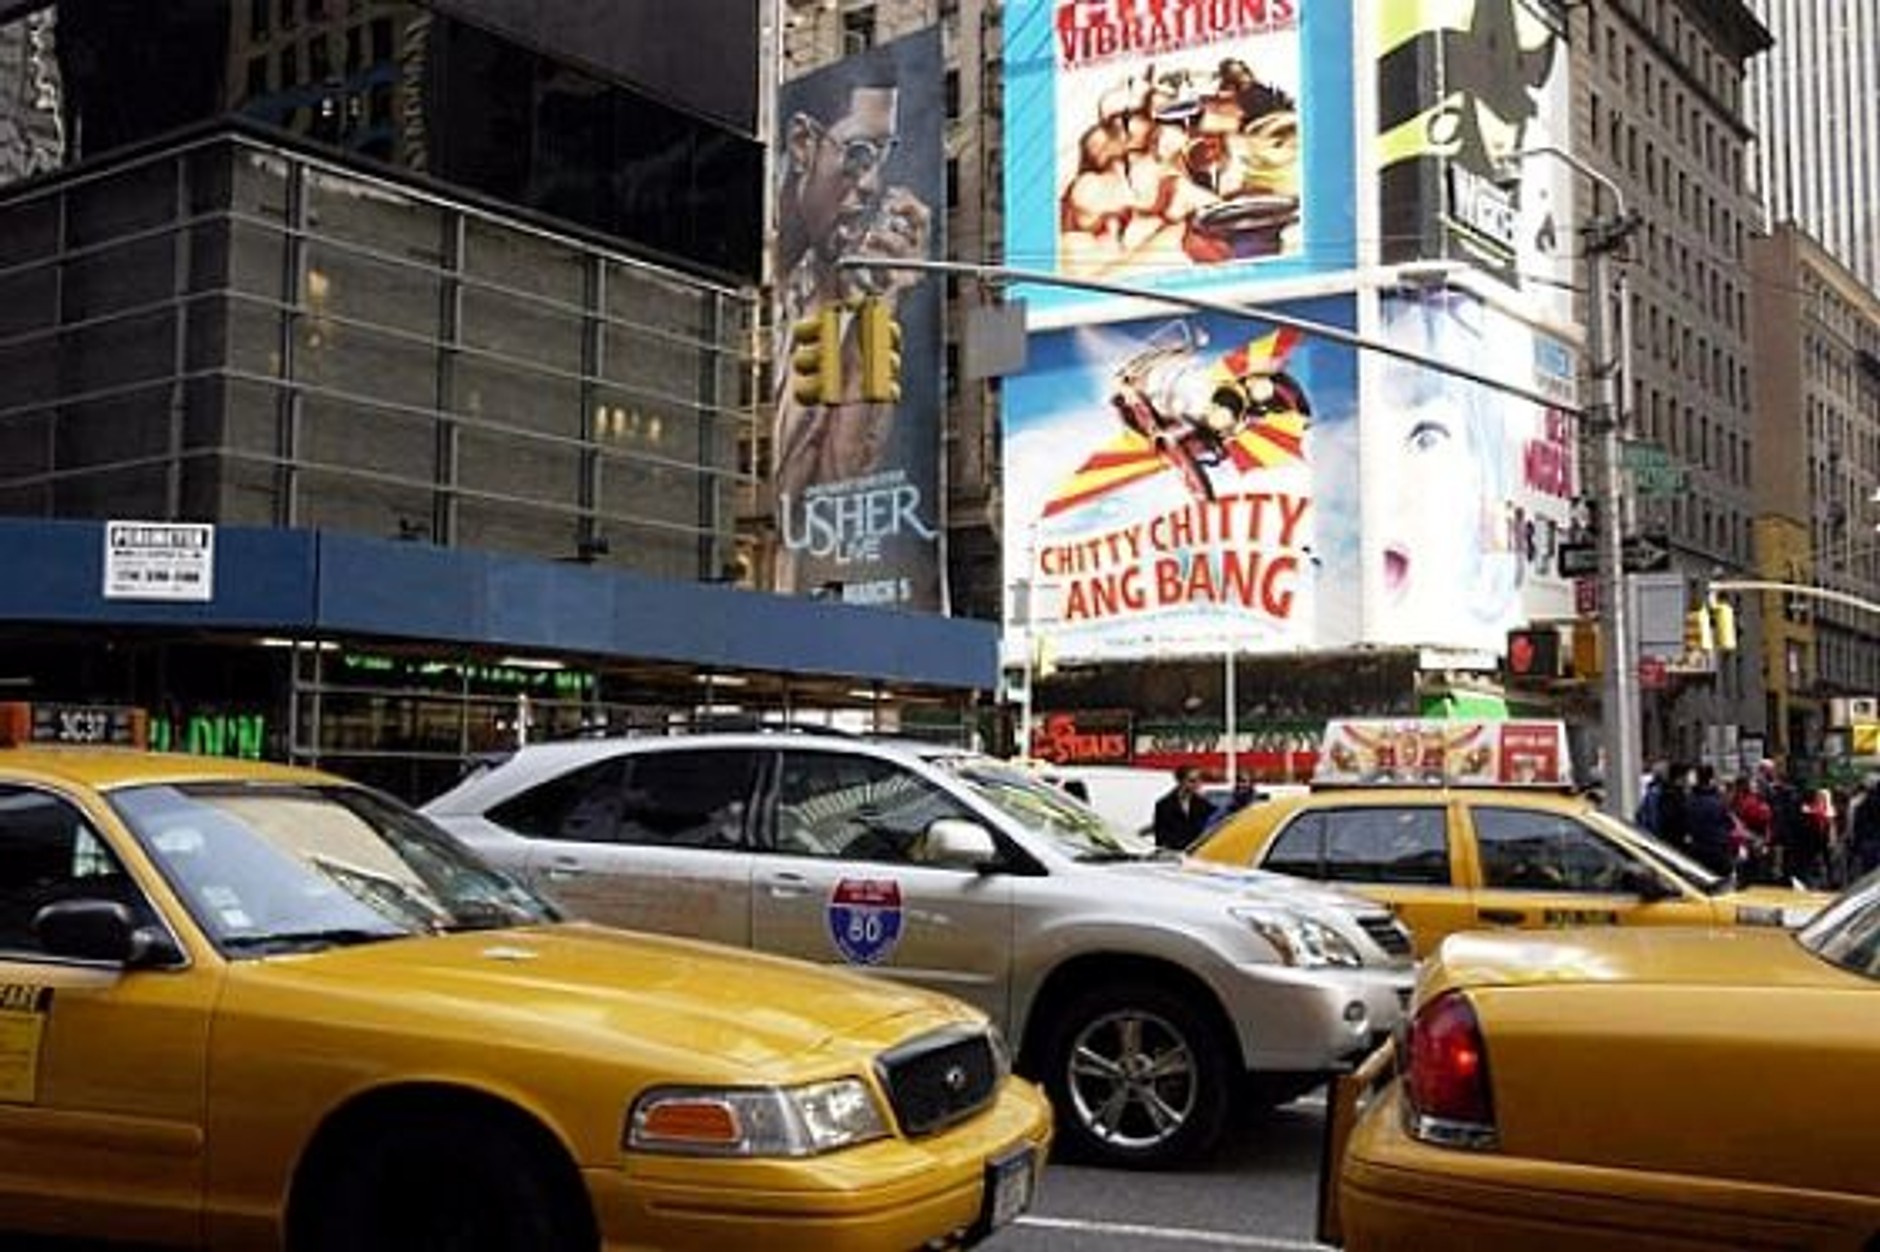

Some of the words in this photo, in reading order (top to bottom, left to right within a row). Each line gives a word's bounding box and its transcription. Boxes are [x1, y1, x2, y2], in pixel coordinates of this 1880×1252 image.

[1059, 0, 1293, 61] VIBRATIONS
[780, 485, 939, 556] USHER
[1041, 525, 1142, 575] CHITTY
[1151, 493, 1309, 551] CHITTY
[1064, 565, 1146, 620] ANG
[1155, 549, 1298, 618] BANG
